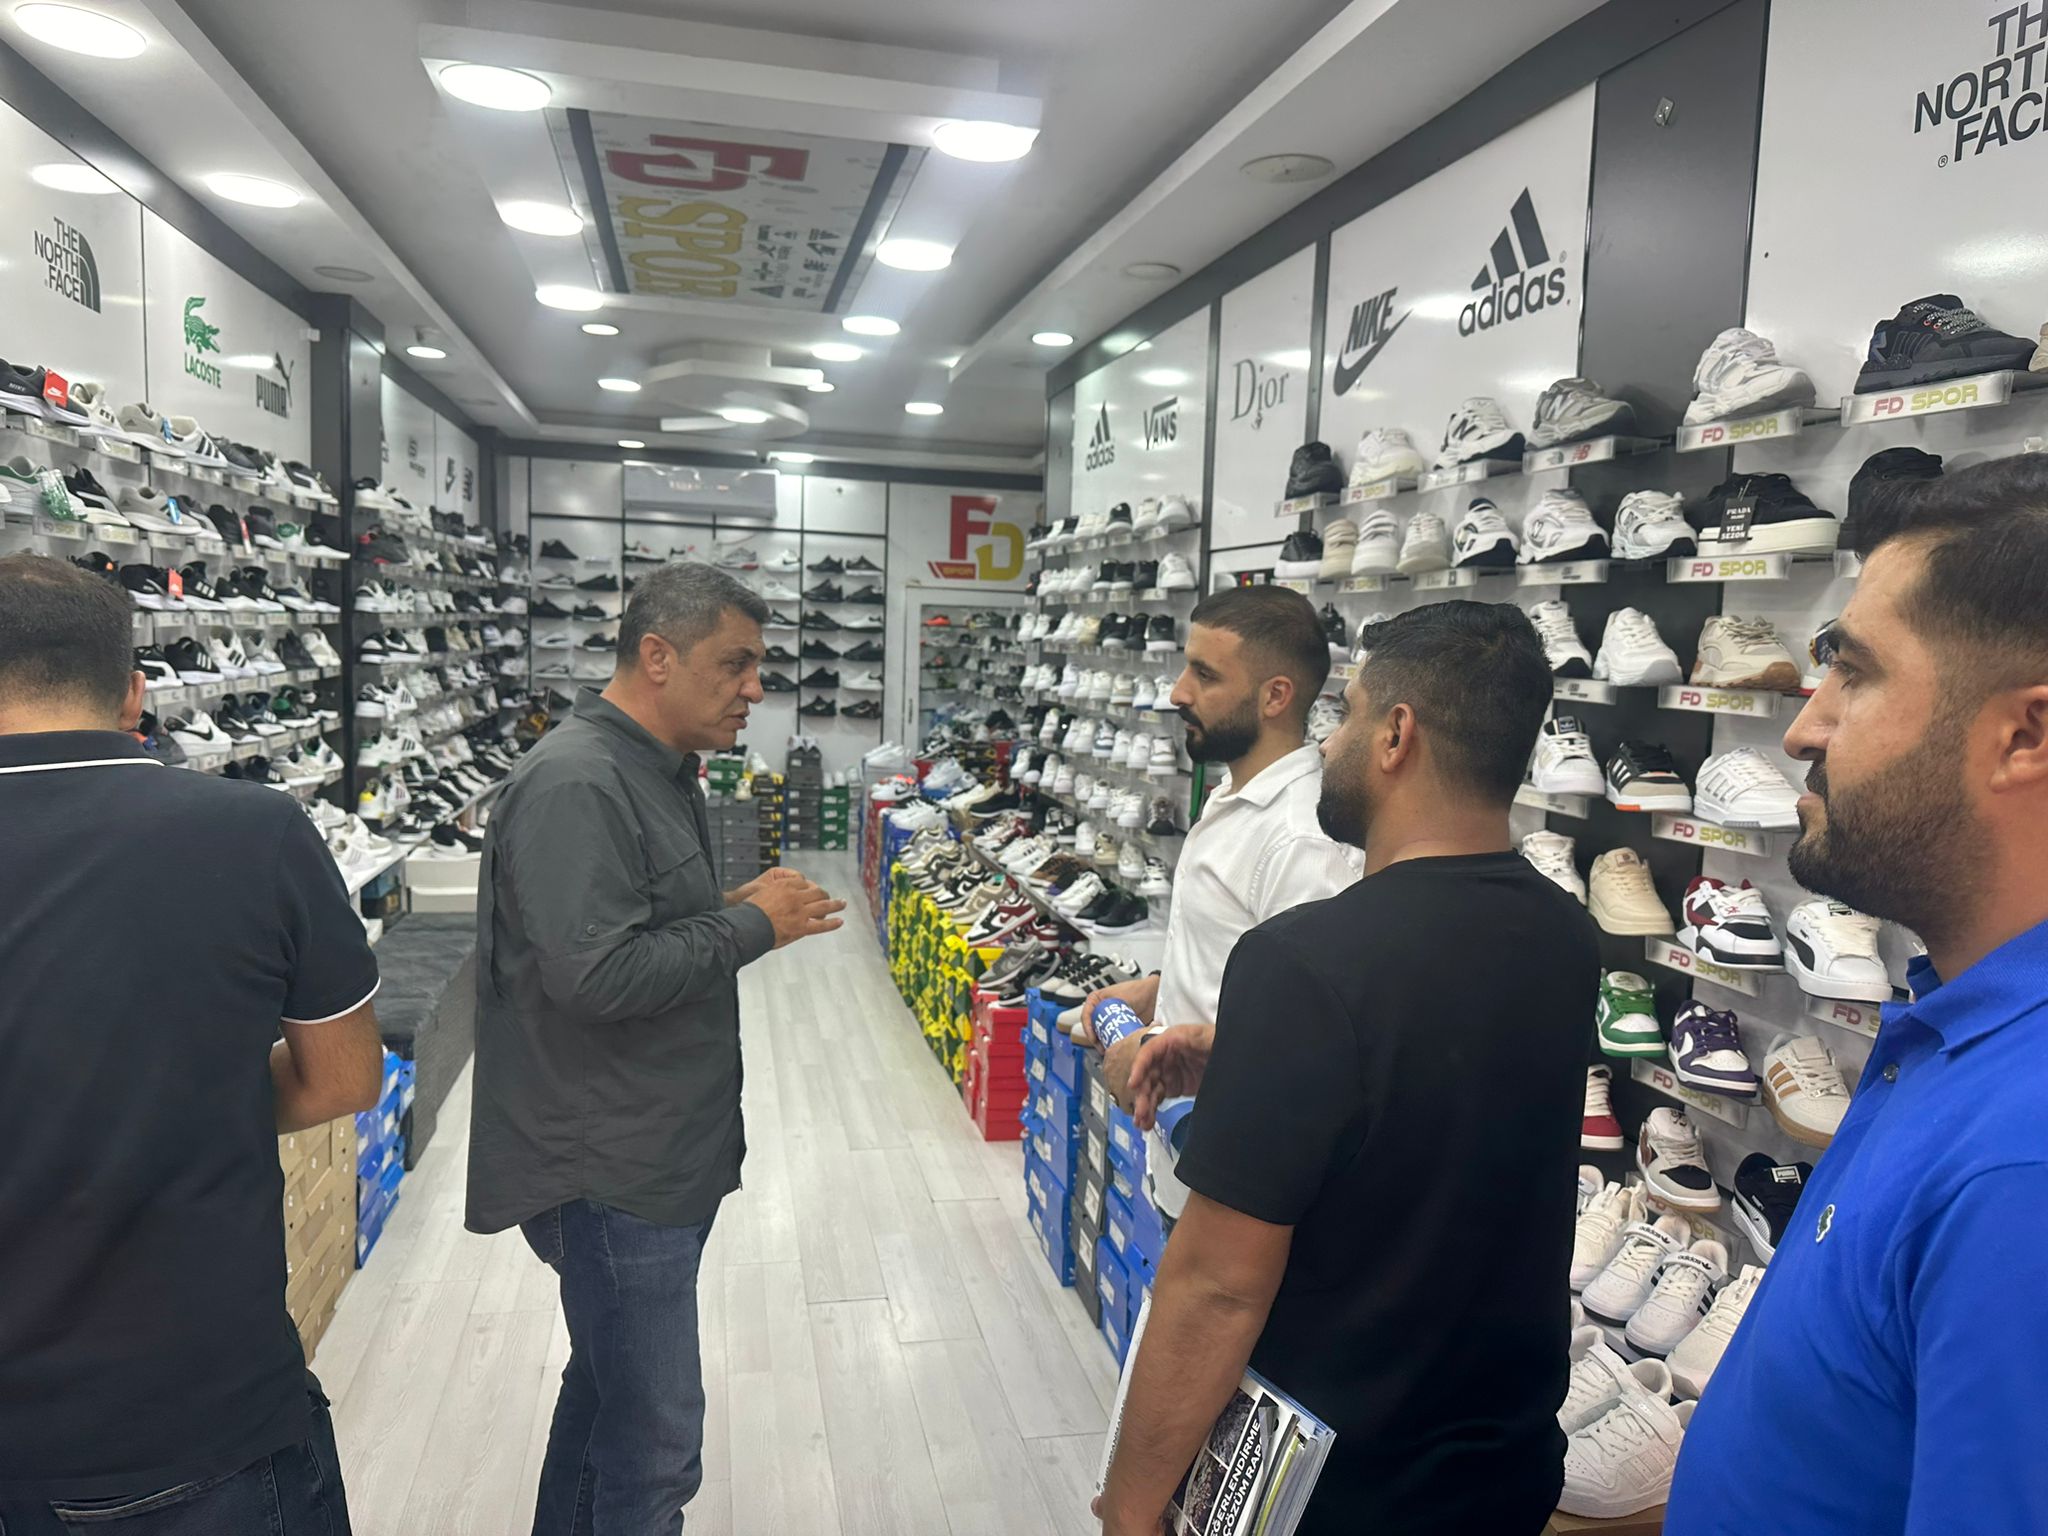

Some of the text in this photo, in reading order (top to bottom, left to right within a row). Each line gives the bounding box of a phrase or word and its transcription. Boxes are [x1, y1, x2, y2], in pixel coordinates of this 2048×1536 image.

[1988, 0, 2048, 57] TH
[1914, 41, 2048, 133] NORT
[1954, 87, 2048, 162] FAC
[34, 230, 79, 278] NORTH
[54, 216, 79, 253] THE
[617, 196, 748, 298] SPOR
[48, 264, 80, 303] FACE
[1459, 268, 1565, 337] adidas
[1345, 287, 1398, 354] NIKE
[185, 352, 221, 389] LACOSTE
[256, 374, 288, 418] PUMA
[1231, 359, 1289, 424] Dior
[1873, 384, 1978, 416] FD SPOR
[1143, 396, 1177, 451] VANS
[1701, 418, 1777, 443] FD SPOR
[1726, 506, 1752, 516] PRADA
[950, 495, 1024, 581] FD
[1721, 531, 1746, 540] SEZON
[1691, 559, 1767, 577] FD SPOR
[1680, 691, 1754, 711] FD SPOR
[1673, 822, 1747, 848] FD SPOR
[1669, 950, 1690, 968] FD
[1095, 1003, 1136, 1034] ALIŞA
[1832, 1003, 1862, 1026] FD
[1653, 1070, 1673, 1090] FD
[1209, 1418, 1261, 1536] EĞERLENDİRME
[1244, 1437, 1263, 1482] RAP
